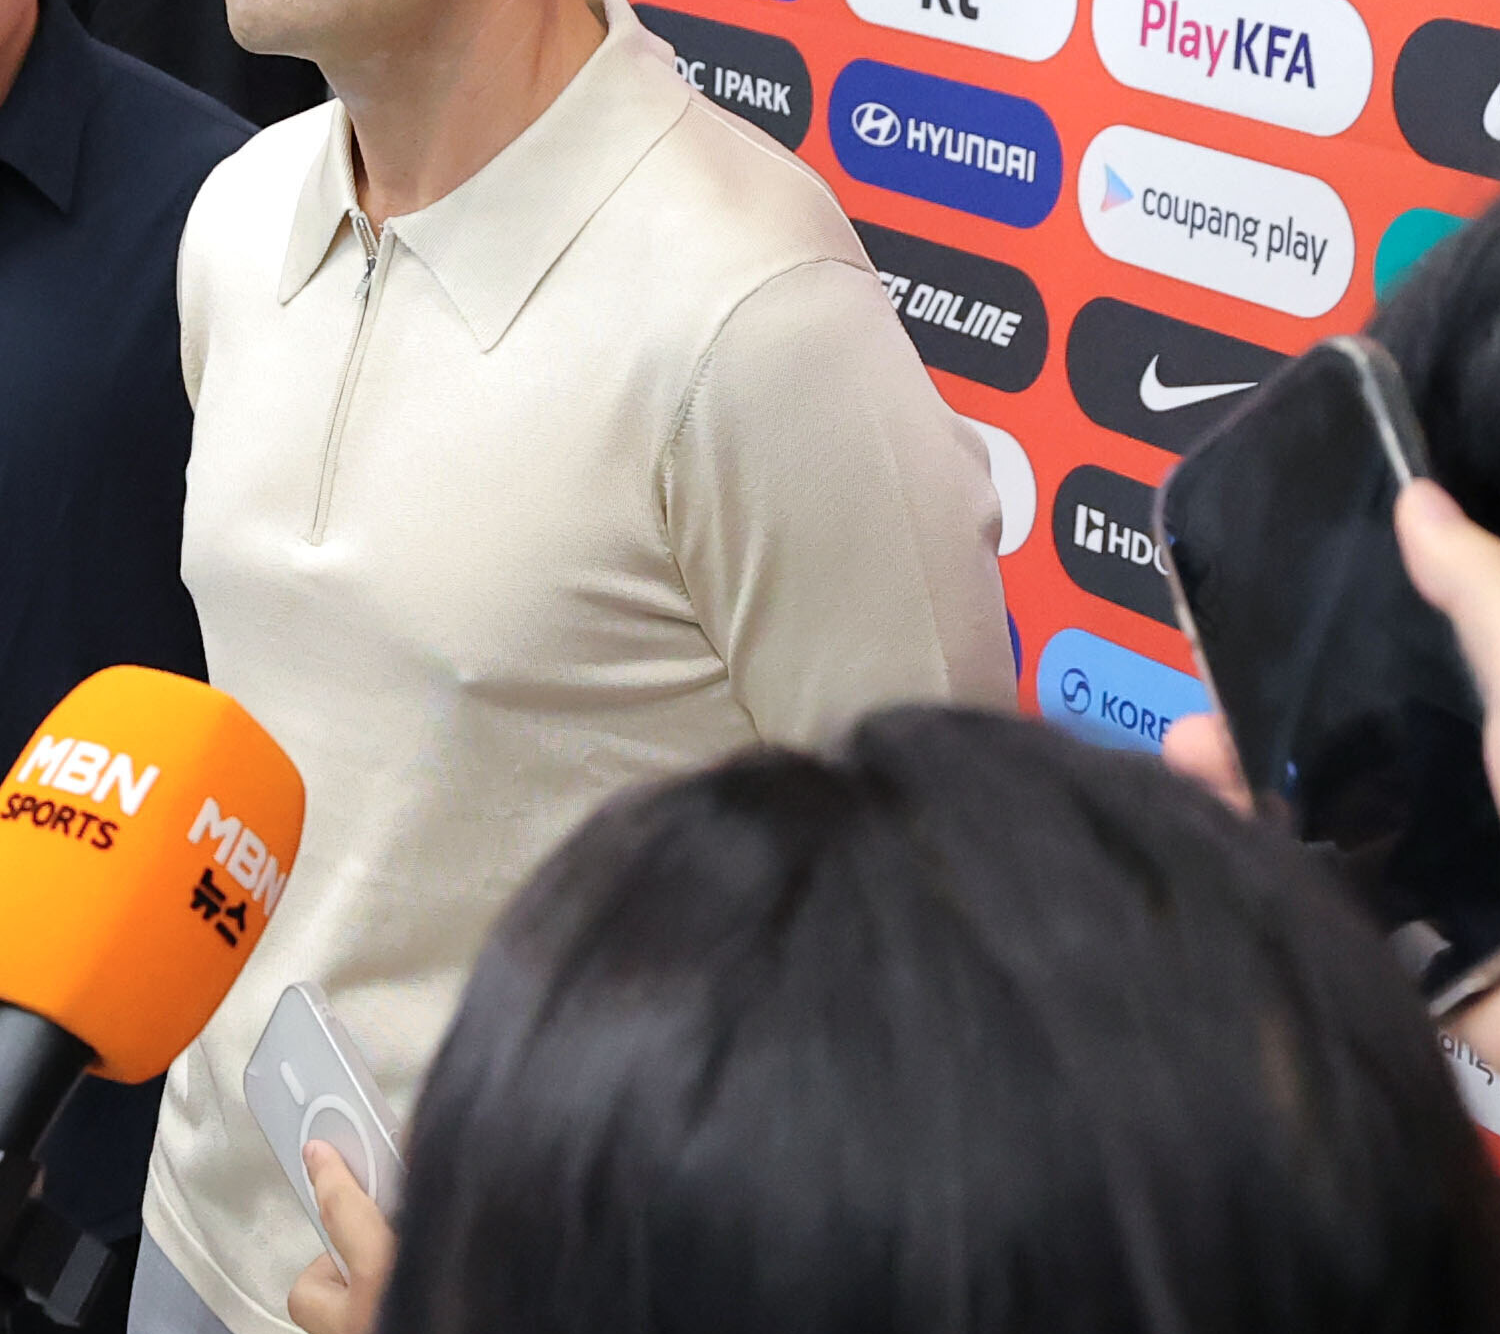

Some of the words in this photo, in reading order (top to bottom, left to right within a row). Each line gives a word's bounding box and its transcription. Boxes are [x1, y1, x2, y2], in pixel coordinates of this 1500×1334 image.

[674, 56, 706, 91] DC
[714, 67, 791, 116] IPARK
[907, 118, 1035, 182] HYUNDAI
[1143, 188, 1260, 257] coupang
[1267, 226, 1328, 275] play
[906, 280, 1022, 348] ONLINE
[1101, 690, 1172, 744] KORE
[15, 735, 160, 816] MBN
[0, 793, 118, 850] SPORTS
[187, 797, 289, 918] MBN
[190, 868, 247, 947] 뉴스
